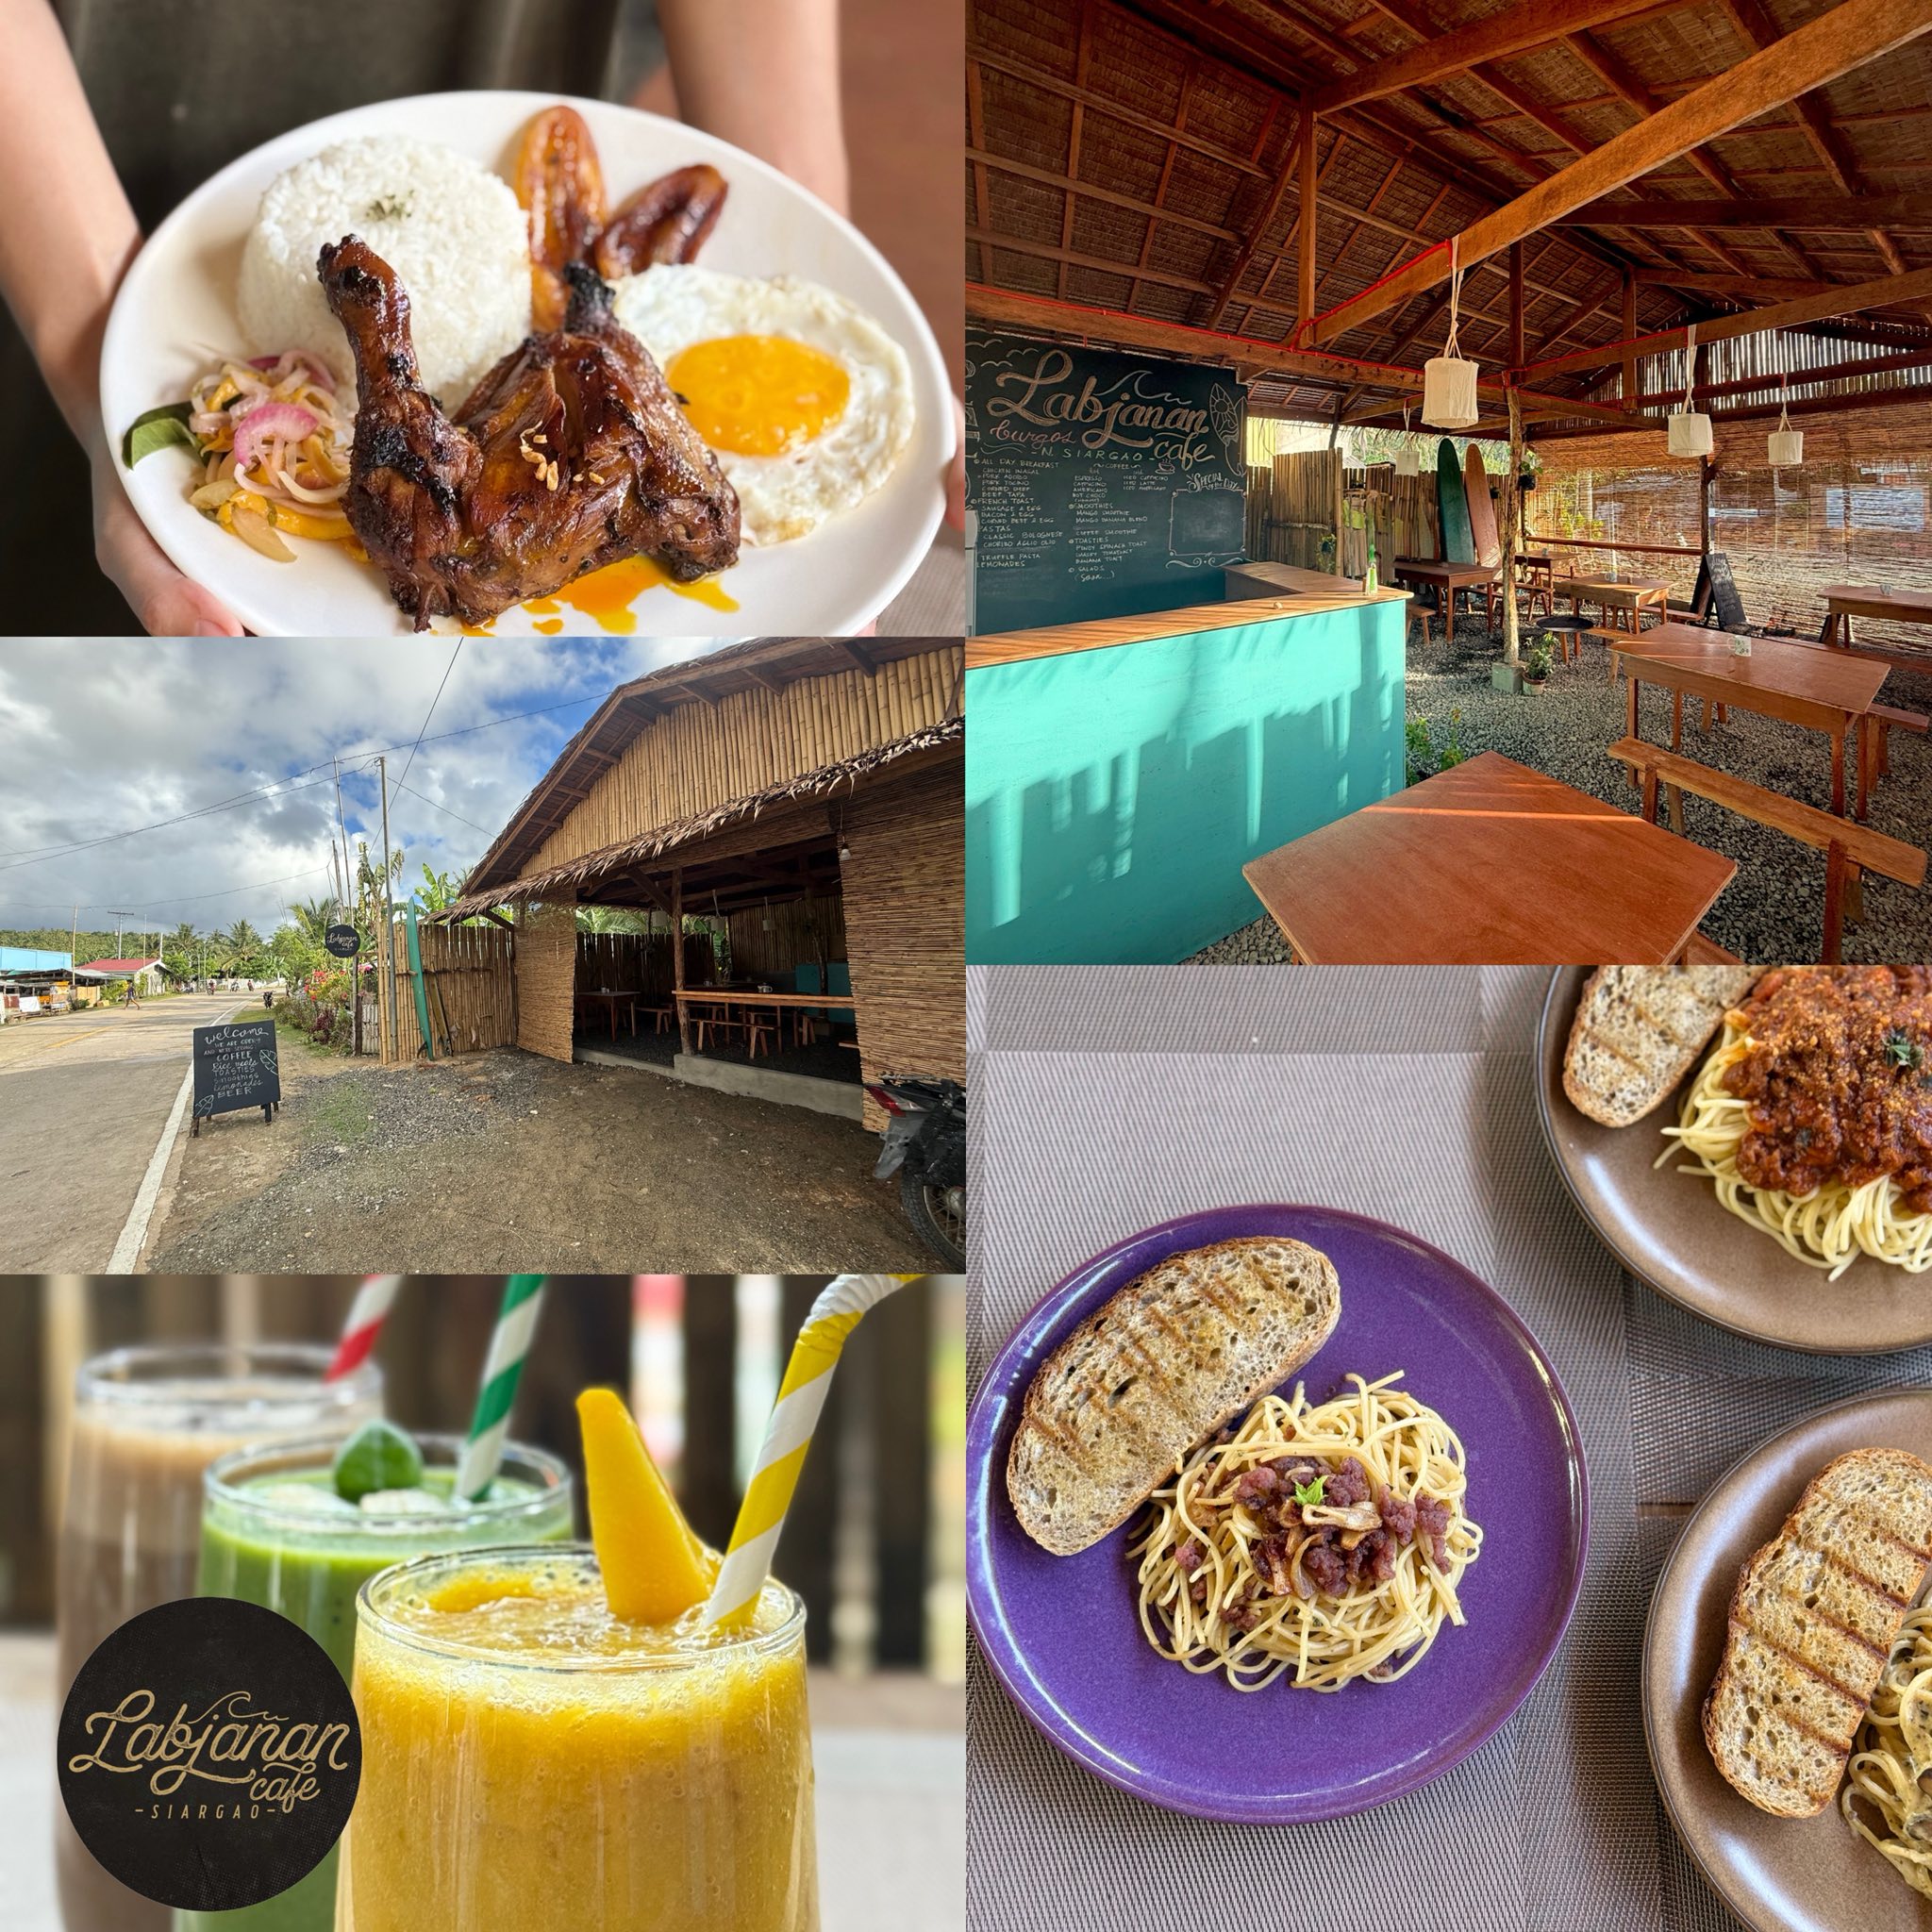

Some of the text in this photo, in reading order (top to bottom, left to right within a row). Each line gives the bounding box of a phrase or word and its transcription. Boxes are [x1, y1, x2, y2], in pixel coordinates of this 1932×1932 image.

[987, 349, 1209, 449] Labjanan
[1154, 433, 1215, 471] cafe
[1020, 459, 1059, 469] BREAKFAST
[217, 1050, 252, 1062] COFFEE
[214, 1066, 255, 1076] TOASTIES
[217, 1086, 252, 1098] BEER
